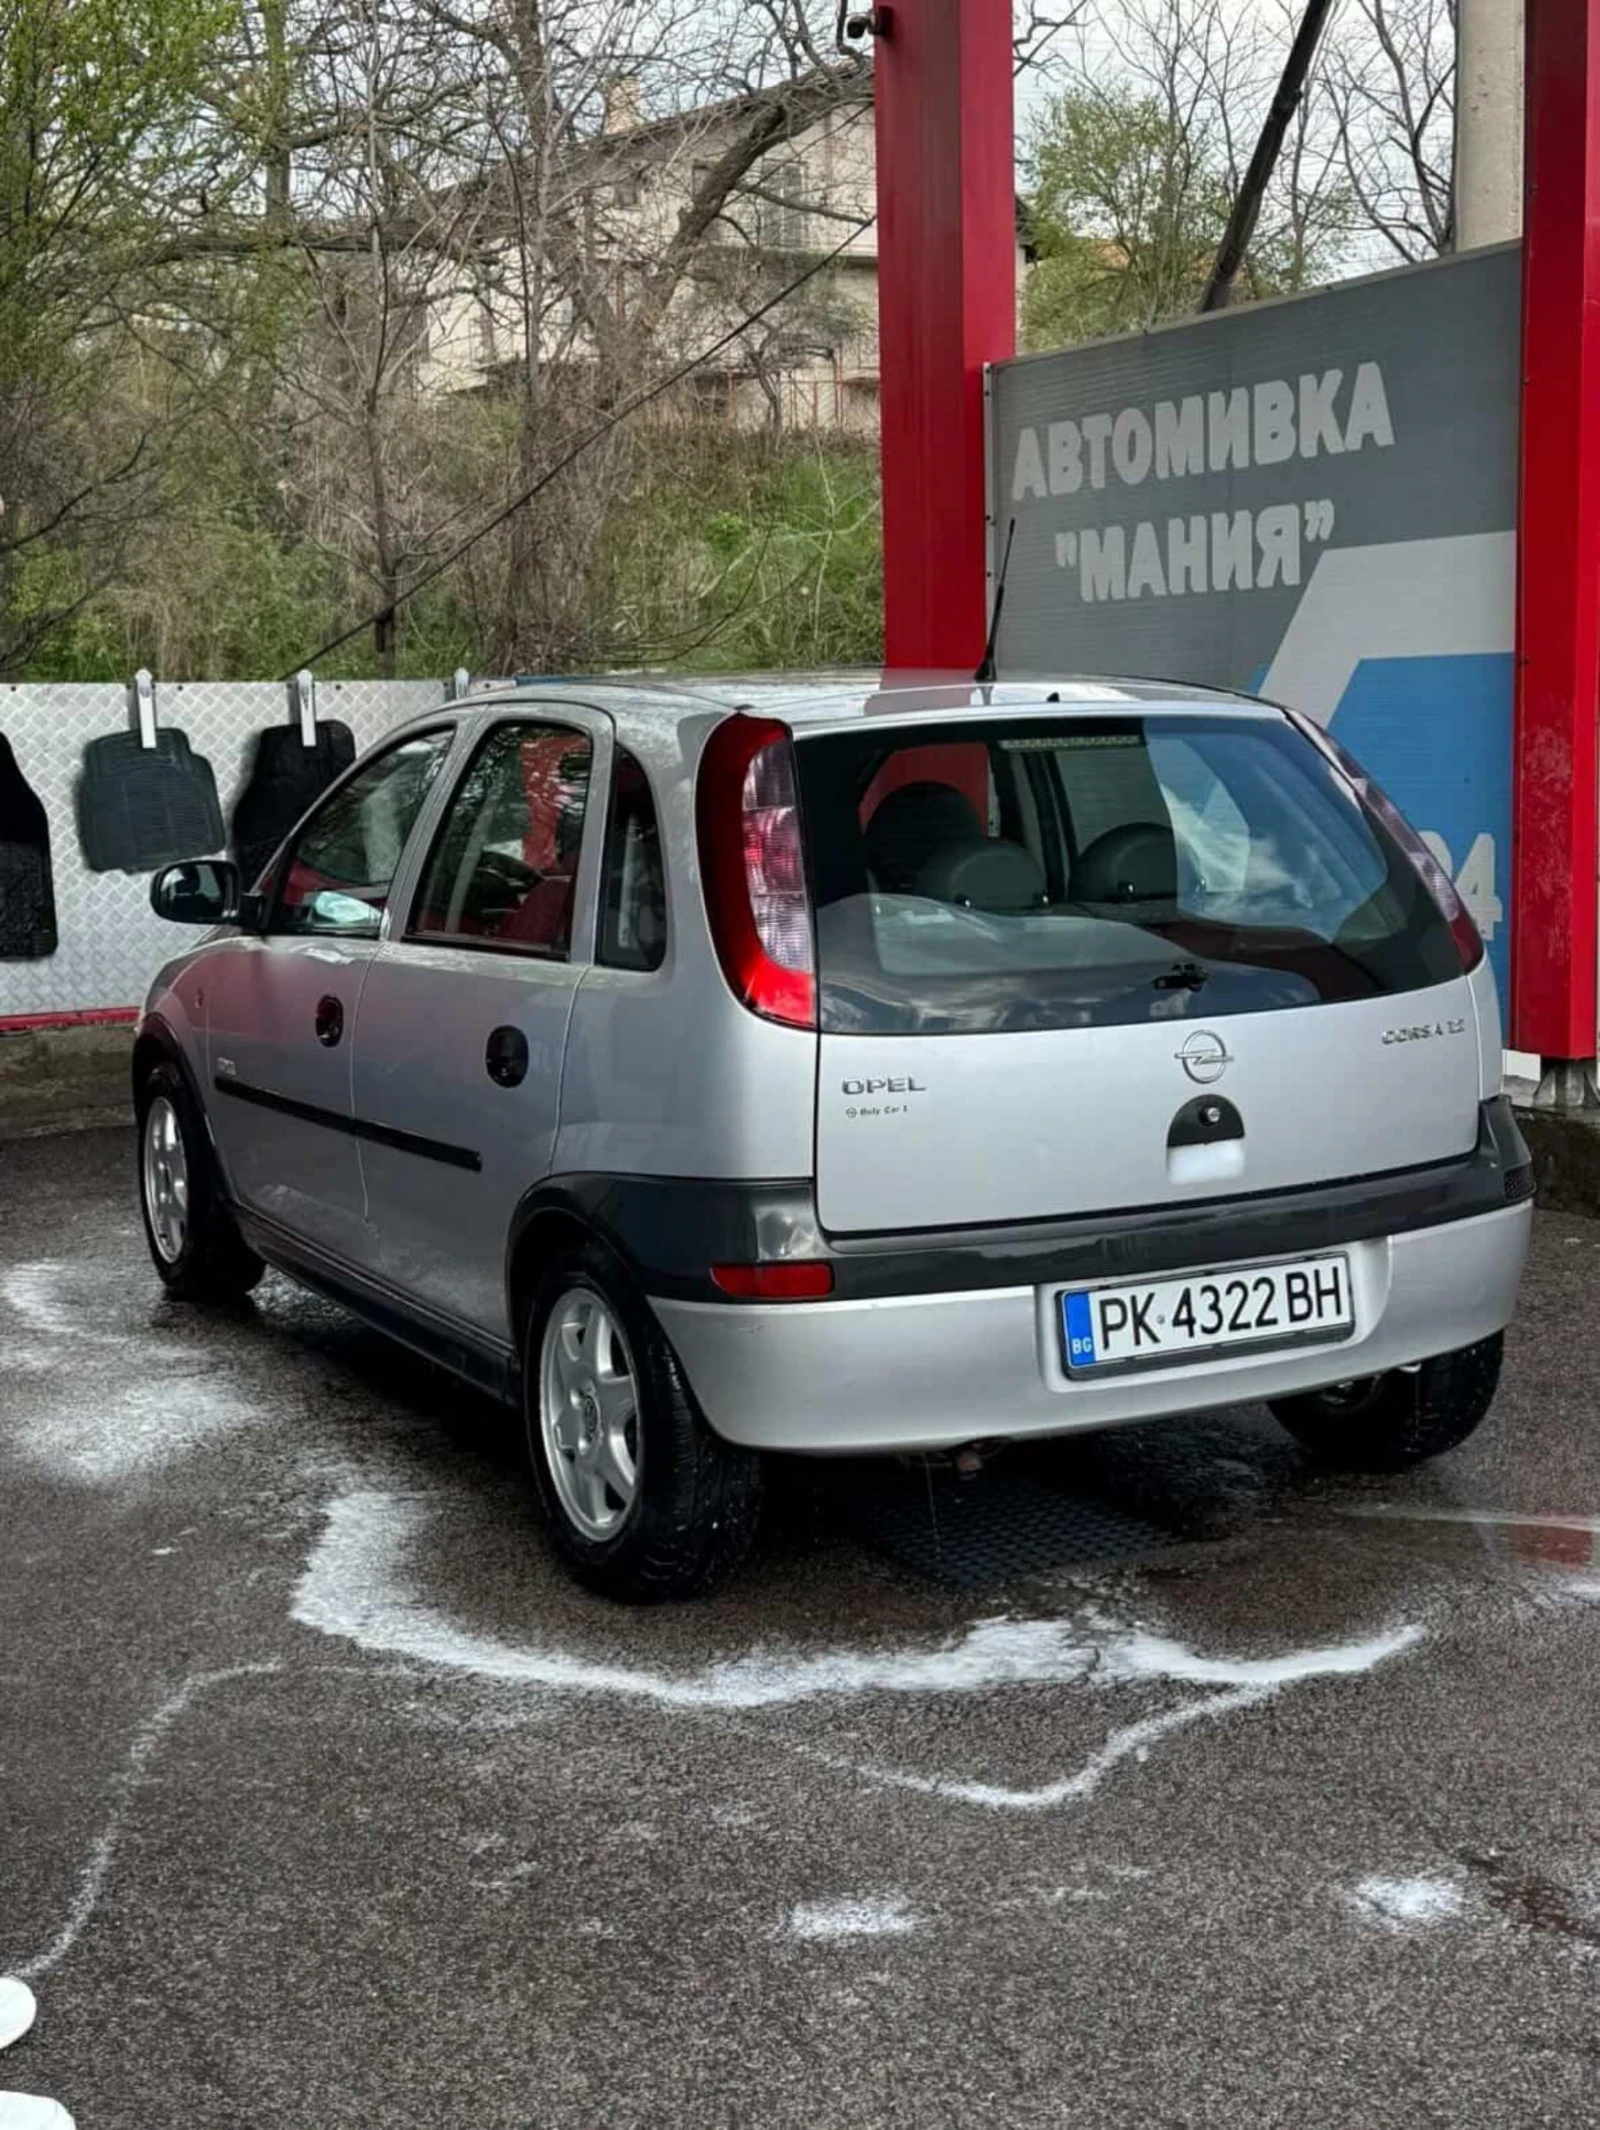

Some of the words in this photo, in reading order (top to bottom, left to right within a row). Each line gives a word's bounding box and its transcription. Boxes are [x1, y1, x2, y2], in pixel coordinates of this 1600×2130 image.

[1011, 361, 1396, 500] АВТОМИВКА
[842, 1076, 927, 1095] OPEL
[1171, 1276, 1279, 1339] 4322
[1285, 1266, 1343, 1323] BH
[1072, 1336, 1092, 1354] BG
